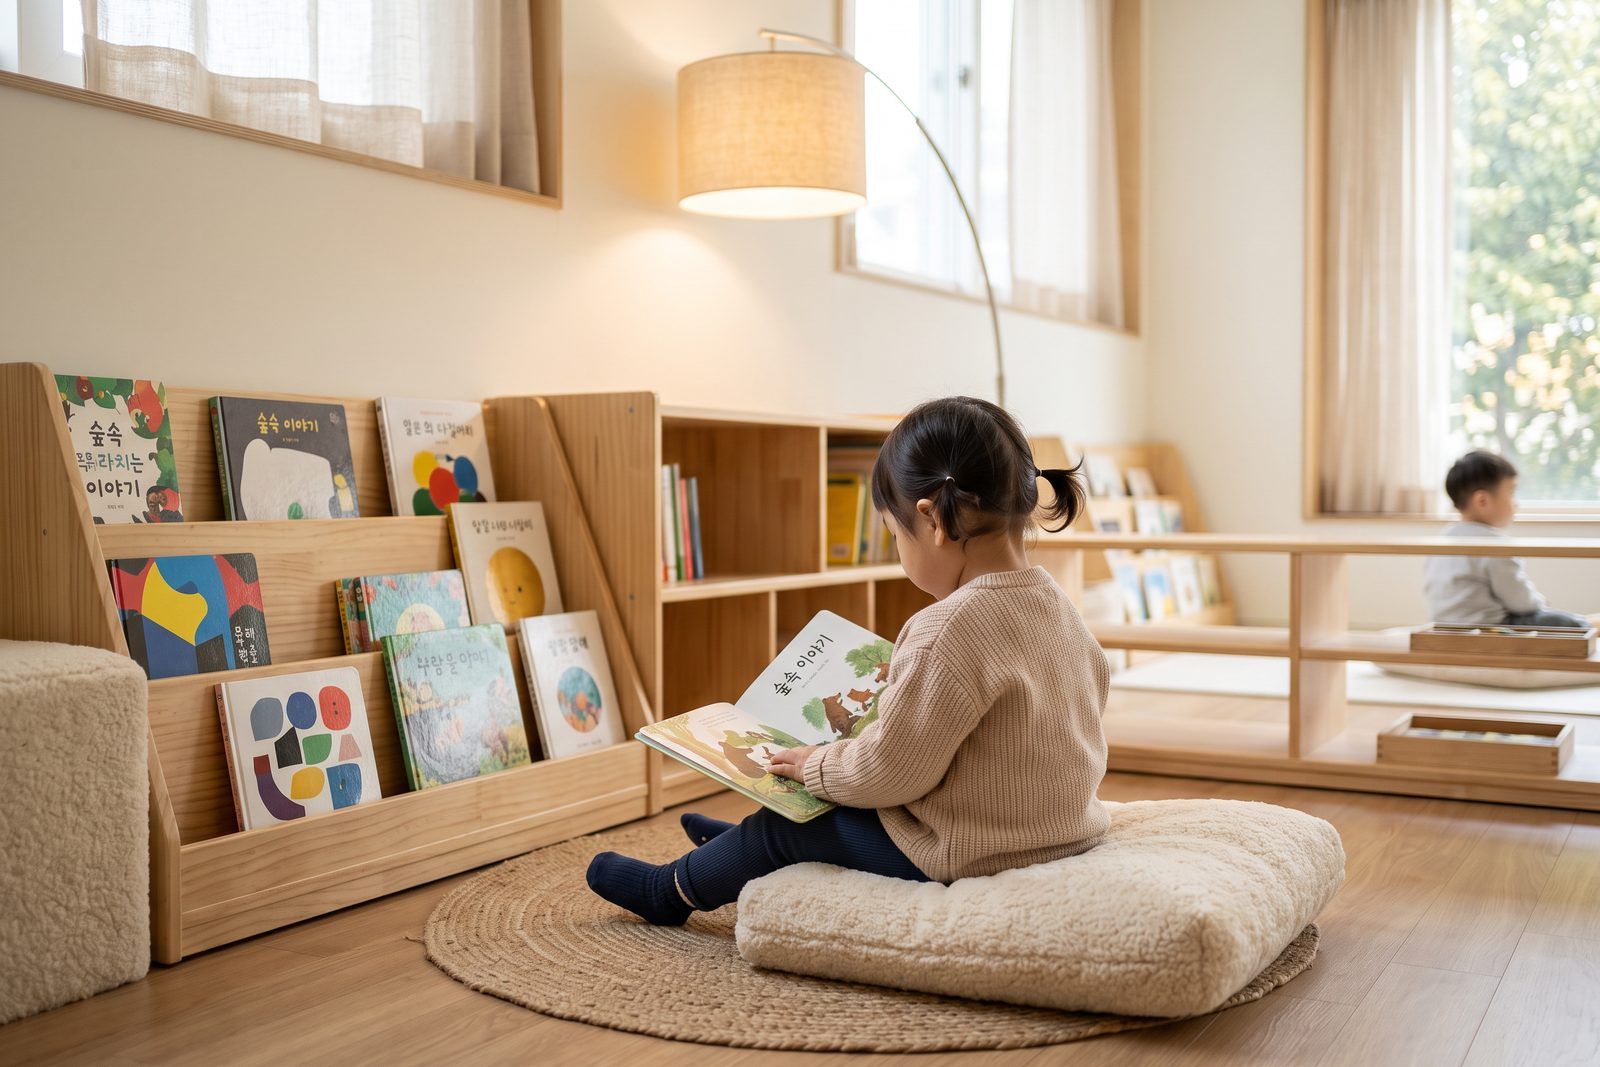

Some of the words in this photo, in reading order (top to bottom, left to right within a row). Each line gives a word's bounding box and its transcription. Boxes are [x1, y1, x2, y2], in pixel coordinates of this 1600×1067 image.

[89, 420, 123, 448] 숲속
[283, 417, 319, 433] 이야기
[86, 478, 140, 498] 이야기
[774, 671, 802, 697] 숲속
[796, 633, 834, 668] 이야기
